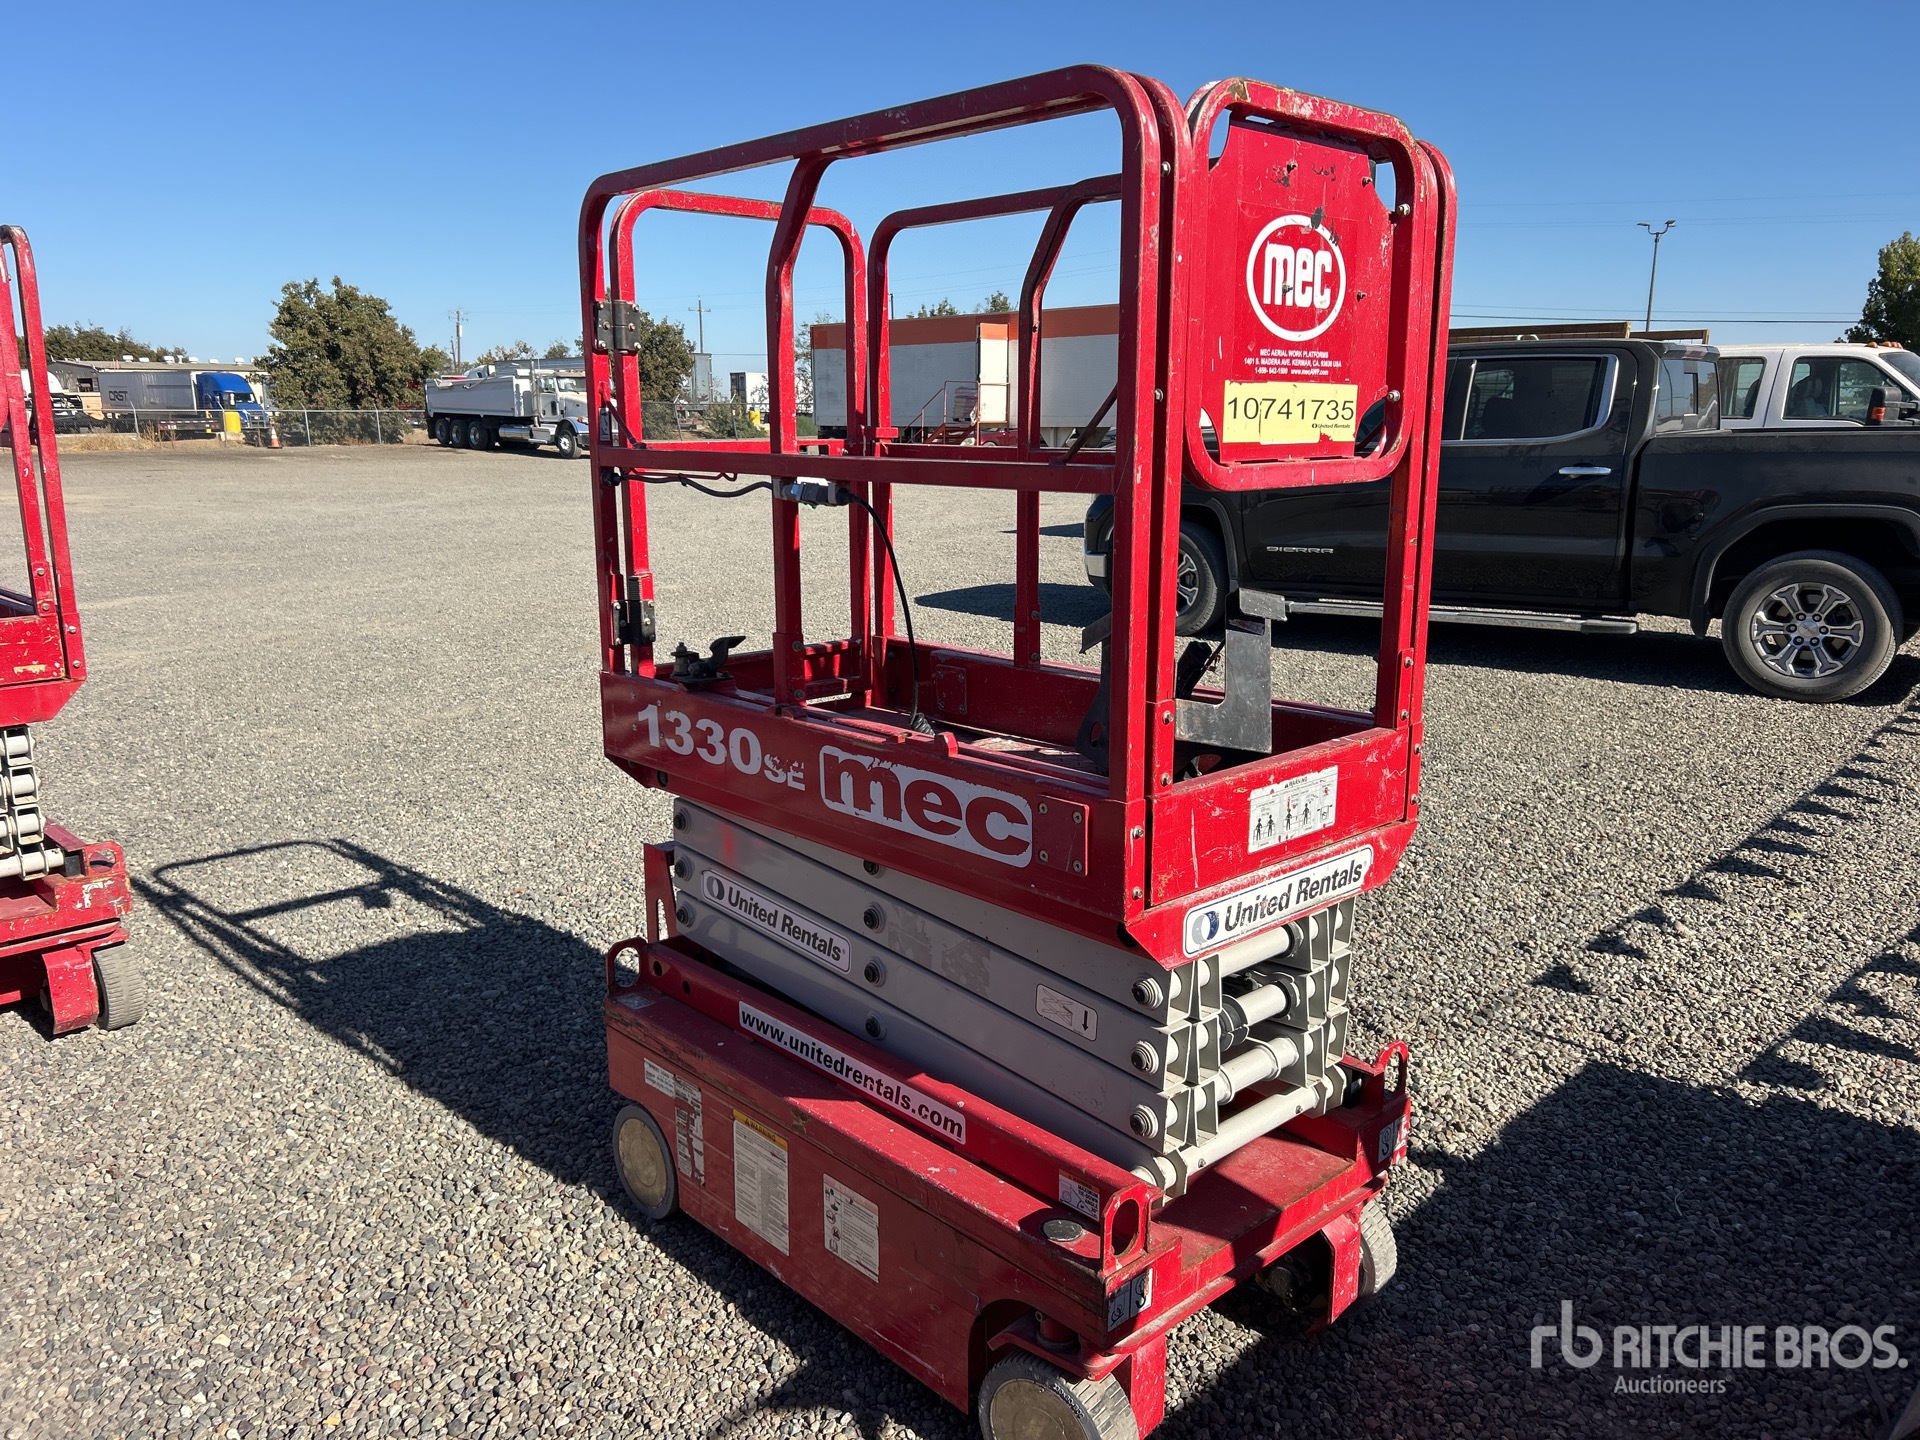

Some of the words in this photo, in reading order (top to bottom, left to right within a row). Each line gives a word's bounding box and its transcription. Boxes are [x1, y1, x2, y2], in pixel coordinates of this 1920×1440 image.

[1260, 358, 1280, 366] MADERA
[1271, 349, 1288, 357] AERIAL
[1288, 350, 1303, 358] WORK
[1303, 351, 1328, 359] PLATFORMS
[1227, 397, 1354, 420] 10741735
[1266, 546, 1334, 554] SIERRA
[823, 752, 1031, 856] mec
[1224, 883, 1293, 932] United
[1295, 859, 1363, 905] Rentals
[728, 886, 779, 928] United
[780, 913, 842, 962] Rentals
[741, 1010, 963, 1139] www.unitedrentals.com
[750, 1121, 776, 1143] WARNING
[1077, 1184, 1098, 1198] MAXIMUM
[1085, 1198, 1098, 1208] ANGLE
